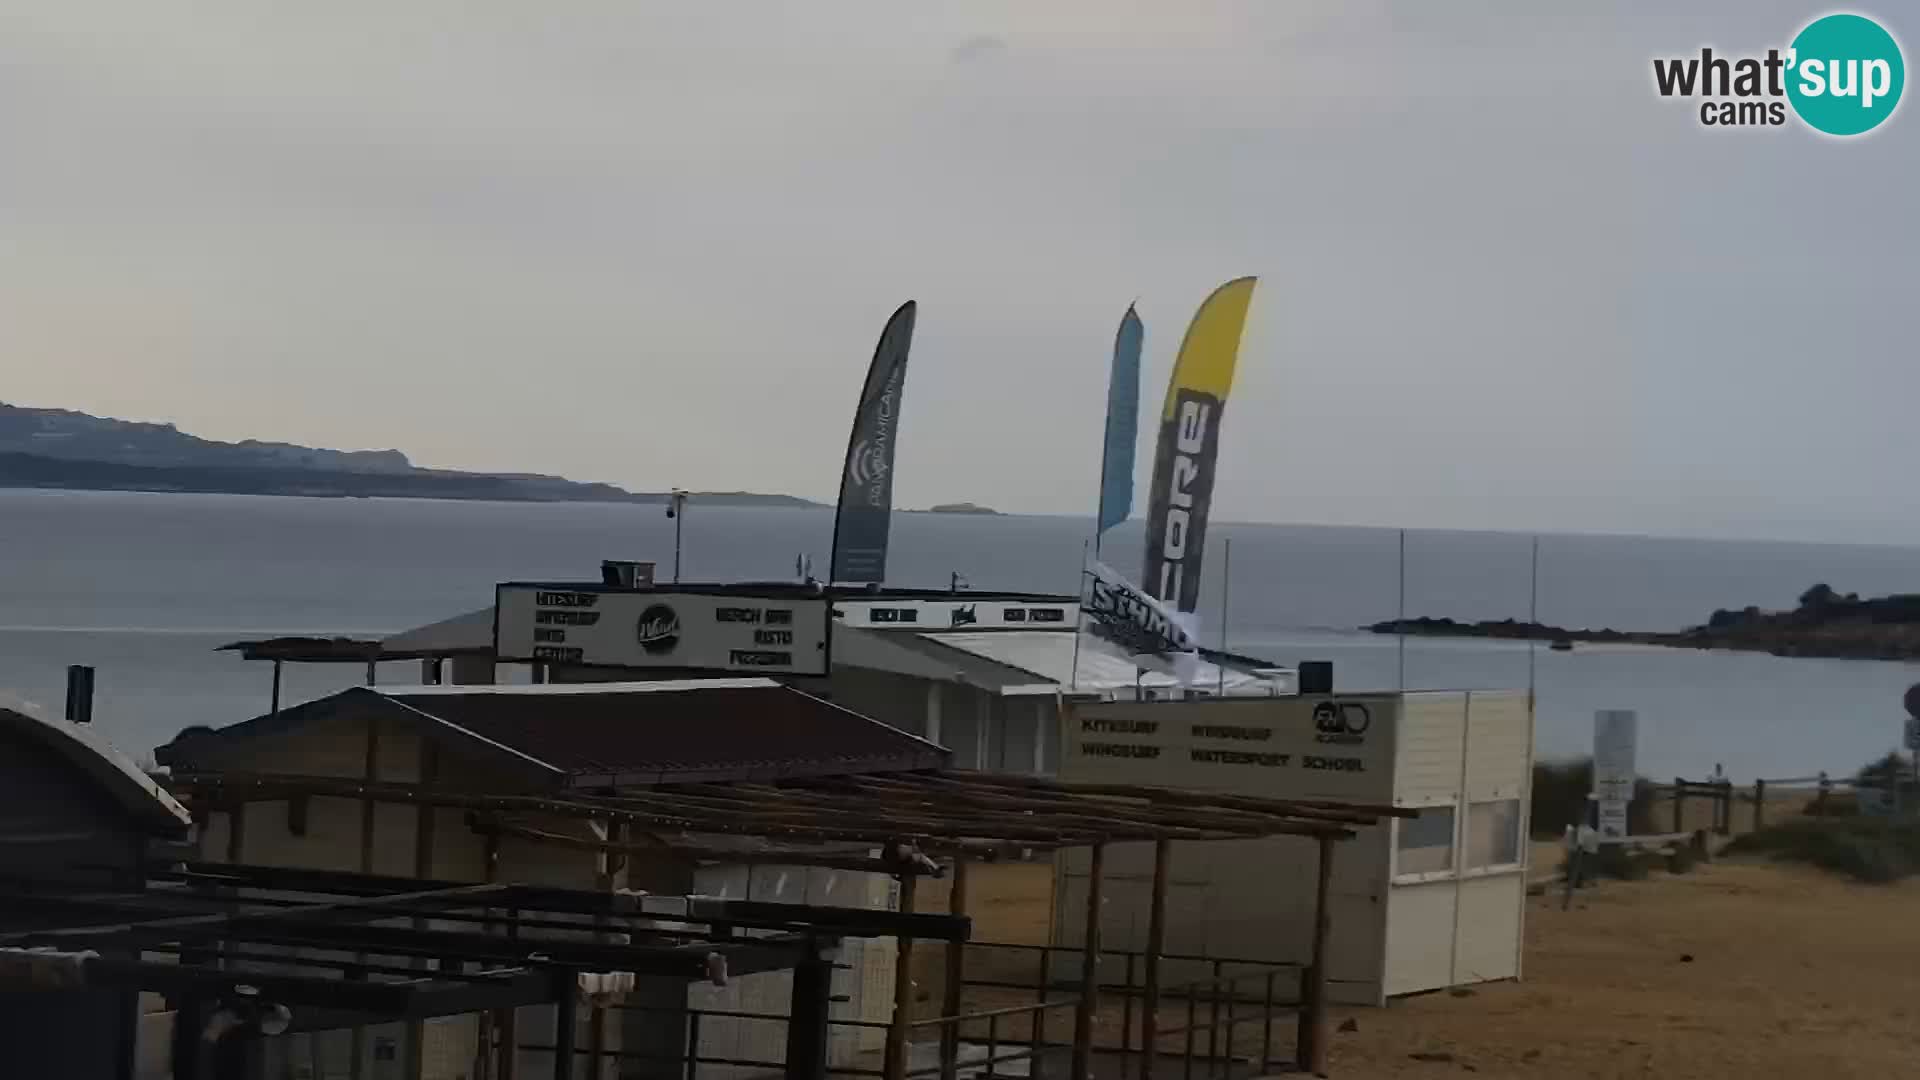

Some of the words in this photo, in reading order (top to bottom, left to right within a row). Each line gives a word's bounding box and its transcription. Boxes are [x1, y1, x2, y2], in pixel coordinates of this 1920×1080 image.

[1081, 719, 1160, 734] KITESURF
[1190, 748, 1291, 768] WATERSPORT
[1302, 754, 1366, 773] SCHOOL
